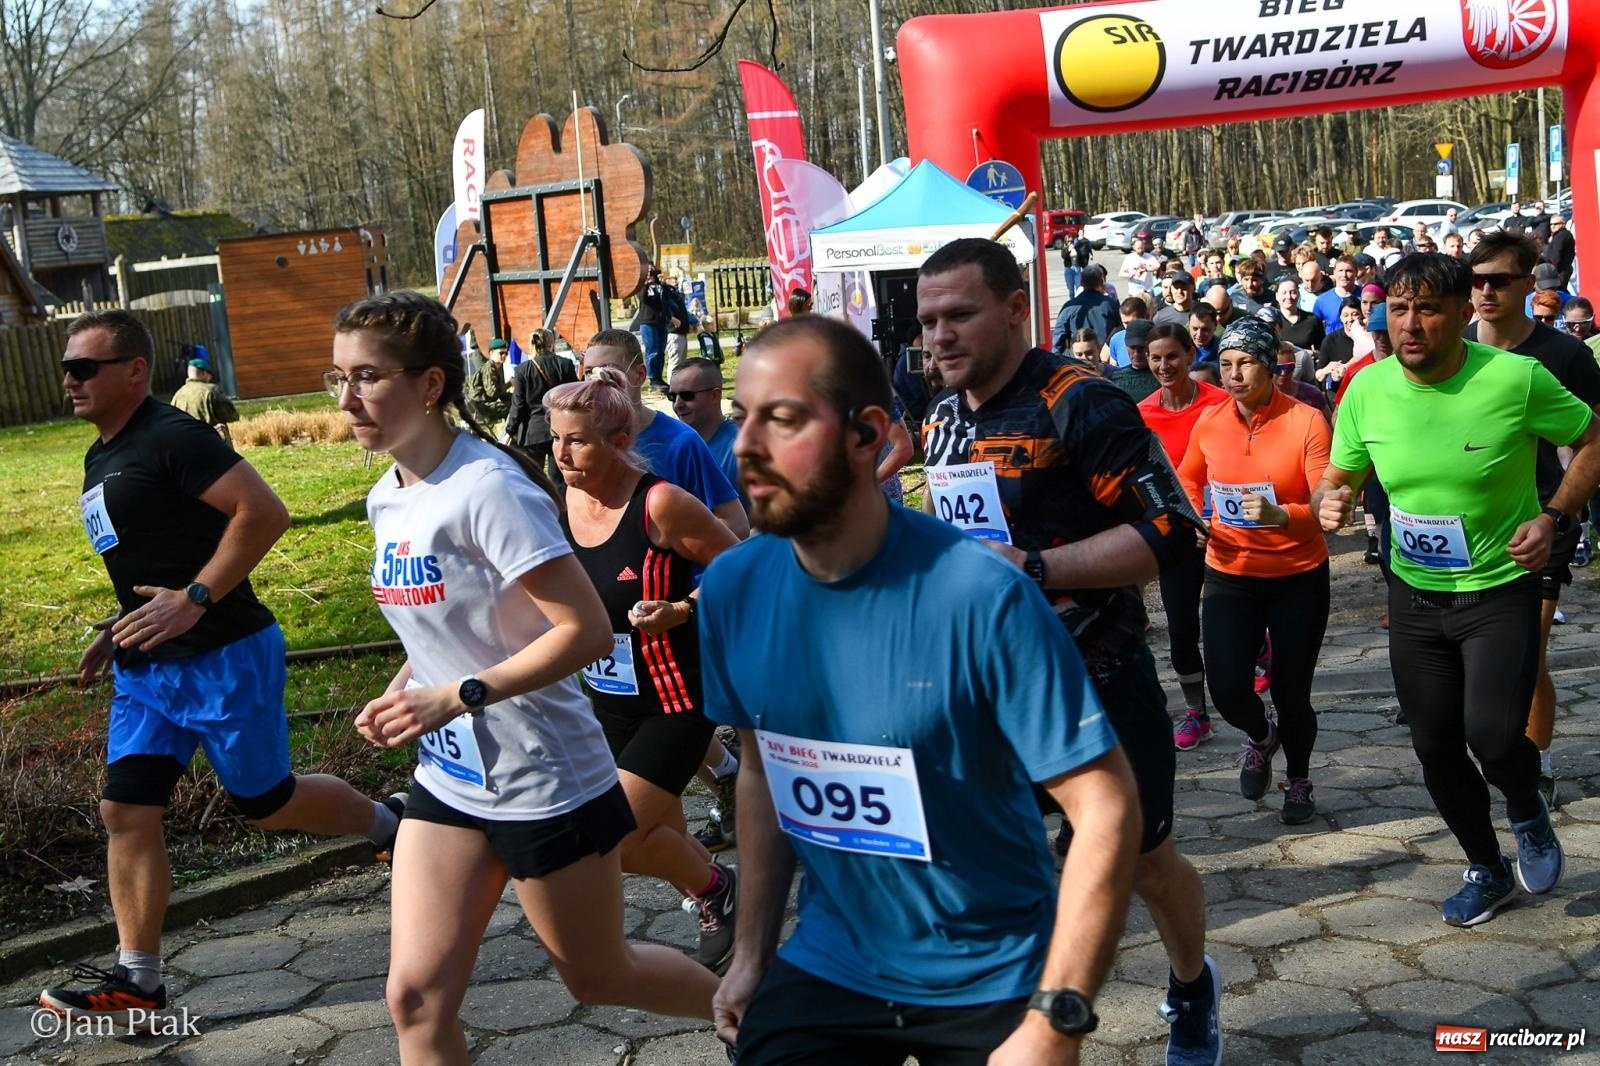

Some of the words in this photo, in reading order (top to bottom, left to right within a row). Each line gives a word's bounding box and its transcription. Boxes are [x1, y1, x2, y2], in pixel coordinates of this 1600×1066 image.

[1258, 0, 1345, 17] BIEG
[1103, 23, 1161, 45] SIR
[1188, 17, 1427, 65] TWARDZIELA
[1213, 59, 1404, 101] RACIBÓRZ
[463, 138, 478, 219] RACI
[940, 493, 989, 525] 042
[1403, 530, 1452, 555] 062
[789, 744, 817, 760] BIEG
[821, 750, 901, 767] TWARDZIELA
[792, 776, 891, 826] 095
